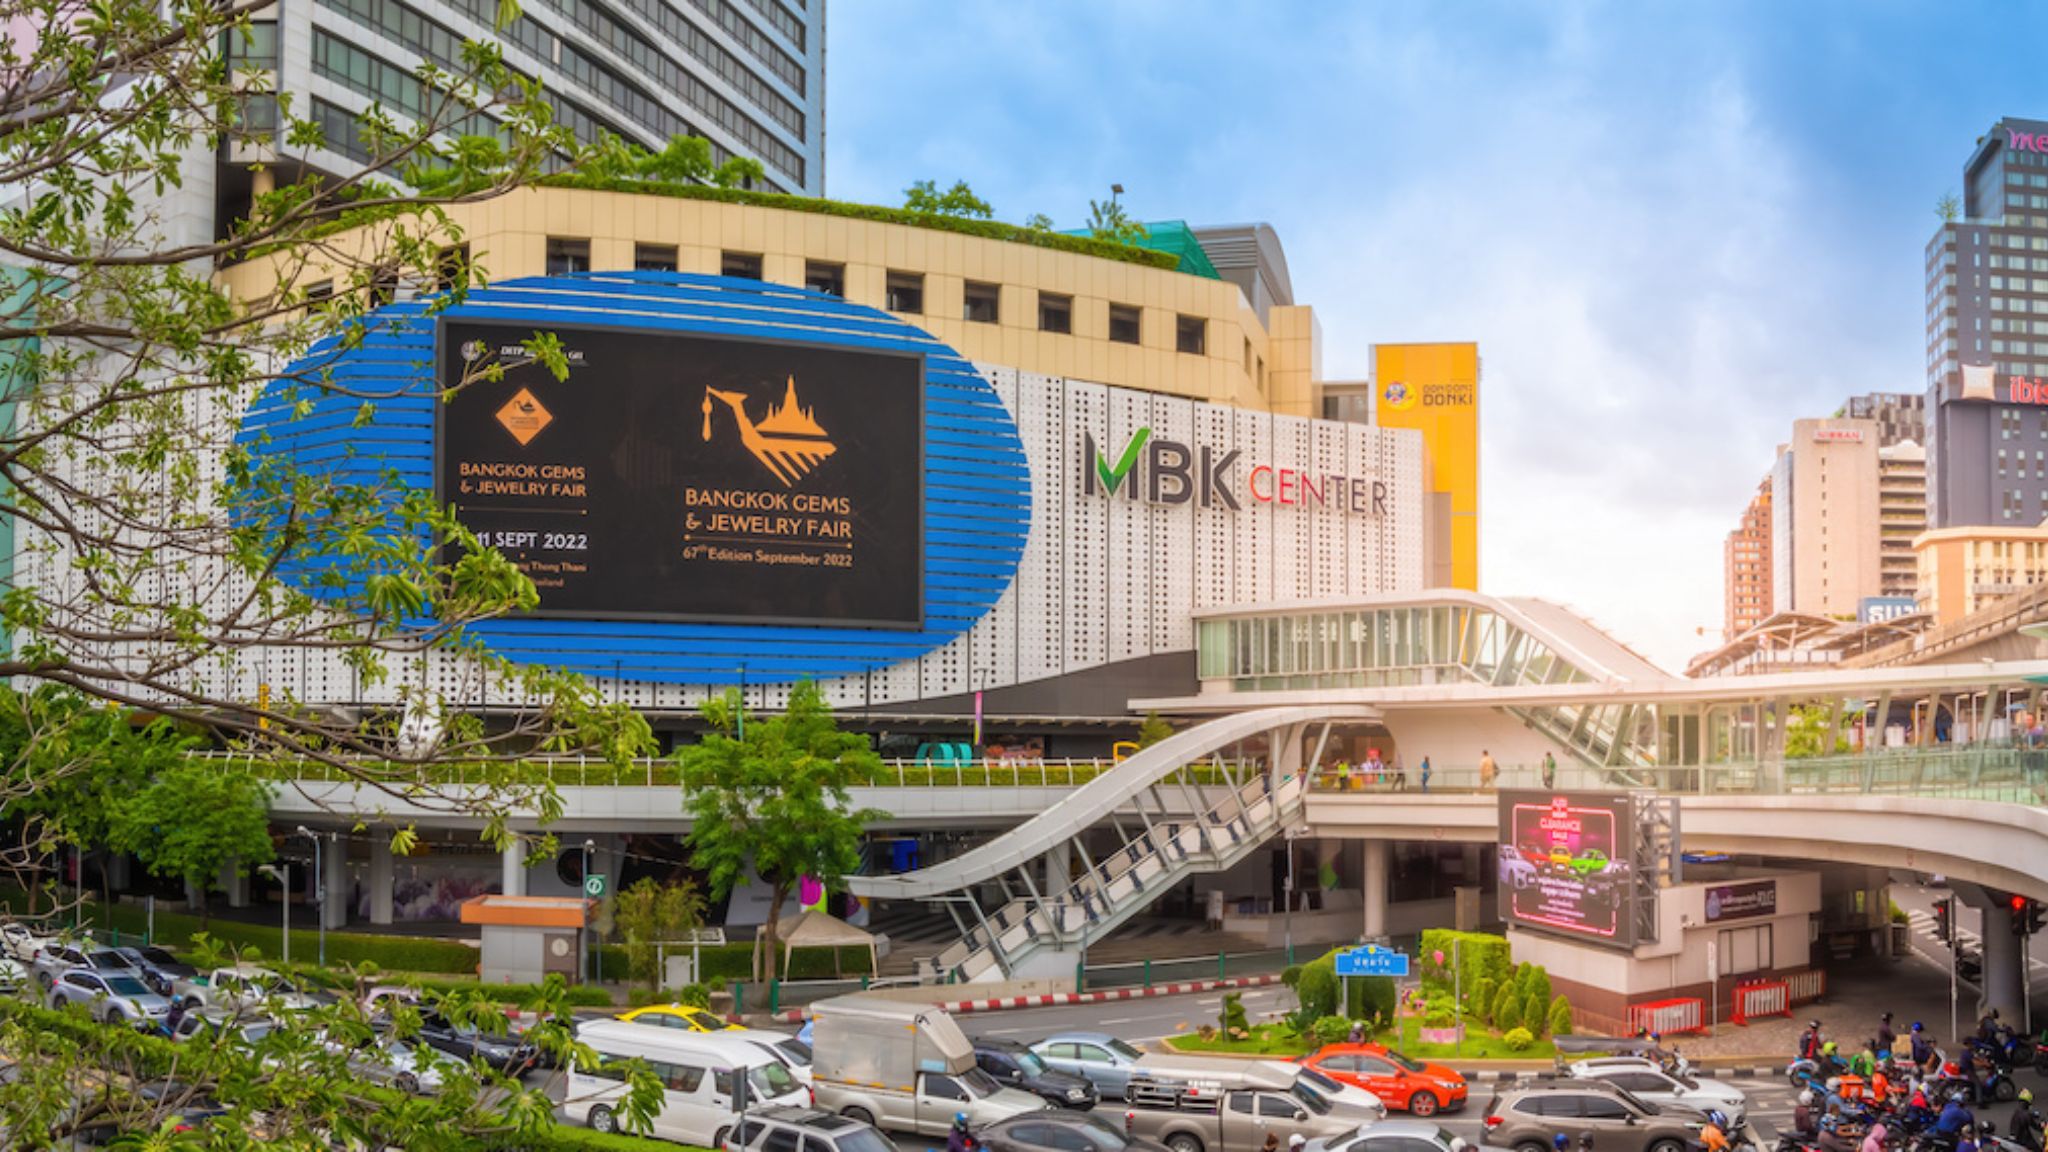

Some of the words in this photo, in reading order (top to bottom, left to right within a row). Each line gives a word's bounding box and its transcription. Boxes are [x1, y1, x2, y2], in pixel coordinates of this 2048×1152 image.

[1423, 394, 1473, 406] DONKI
[460, 463, 538, 478] BANGKOK
[541, 465, 586, 479] GEMS
[1084, 426, 1242, 513] MBK
[1249, 464, 1388, 516] CENTER
[460, 480, 472, 493] &
[475, 481, 549, 495] JEWELRY
[552, 483, 587, 497] FAIR
[685, 487, 788, 511] BANGKOK
[793, 495, 850, 515] GEMS
[685, 512, 702, 530] &
[706, 513, 802, 535] JEWELRY
[807, 519, 852, 538] FAIR
[495, 532, 538, 548] SEPT
[542, 533, 588, 550] 2022
[708, 547, 753, 562] Edition
[755, 550, 820, 566] September
[823, 554, 853, 567] 2022
